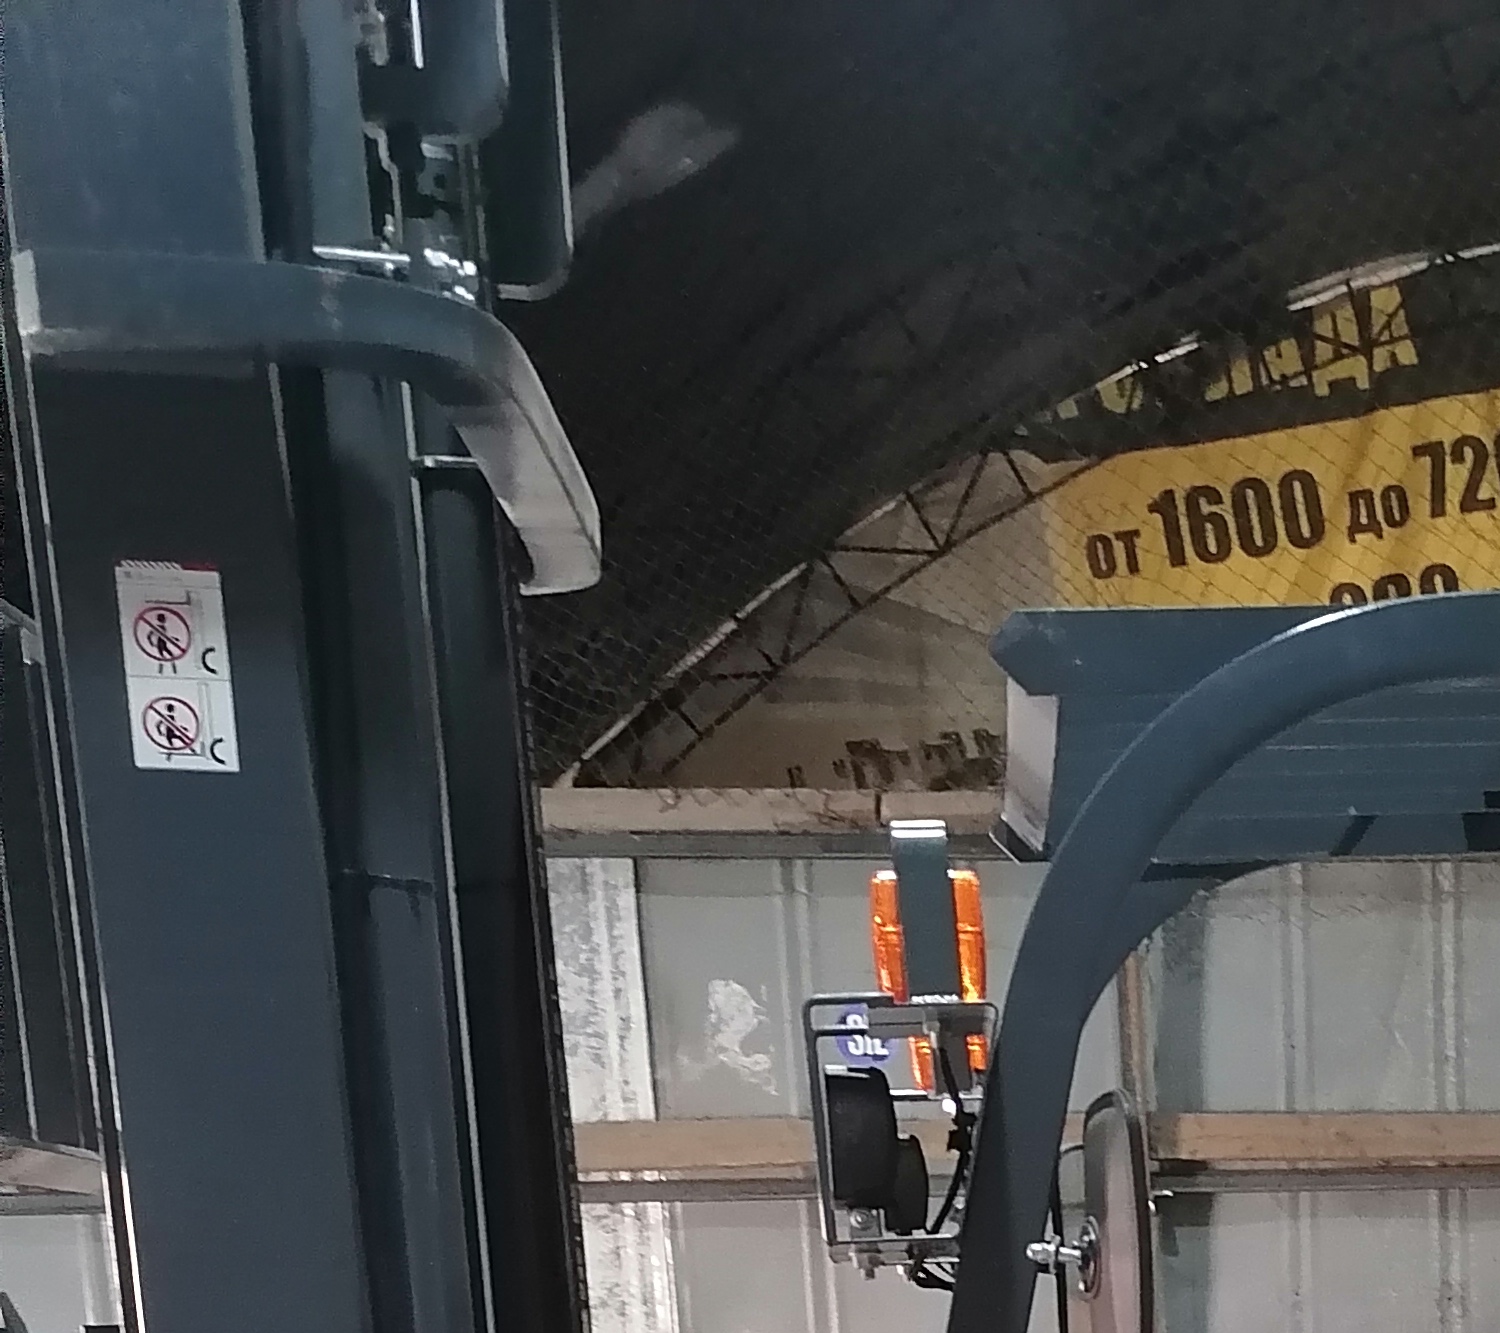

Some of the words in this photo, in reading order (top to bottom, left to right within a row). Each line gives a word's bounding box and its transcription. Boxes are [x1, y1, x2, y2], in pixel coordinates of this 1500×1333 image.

[1085, 529, 1141, 580] от
[1147, 469, 1326, 568] 1600
[1347, 482, 1411, 544] до
